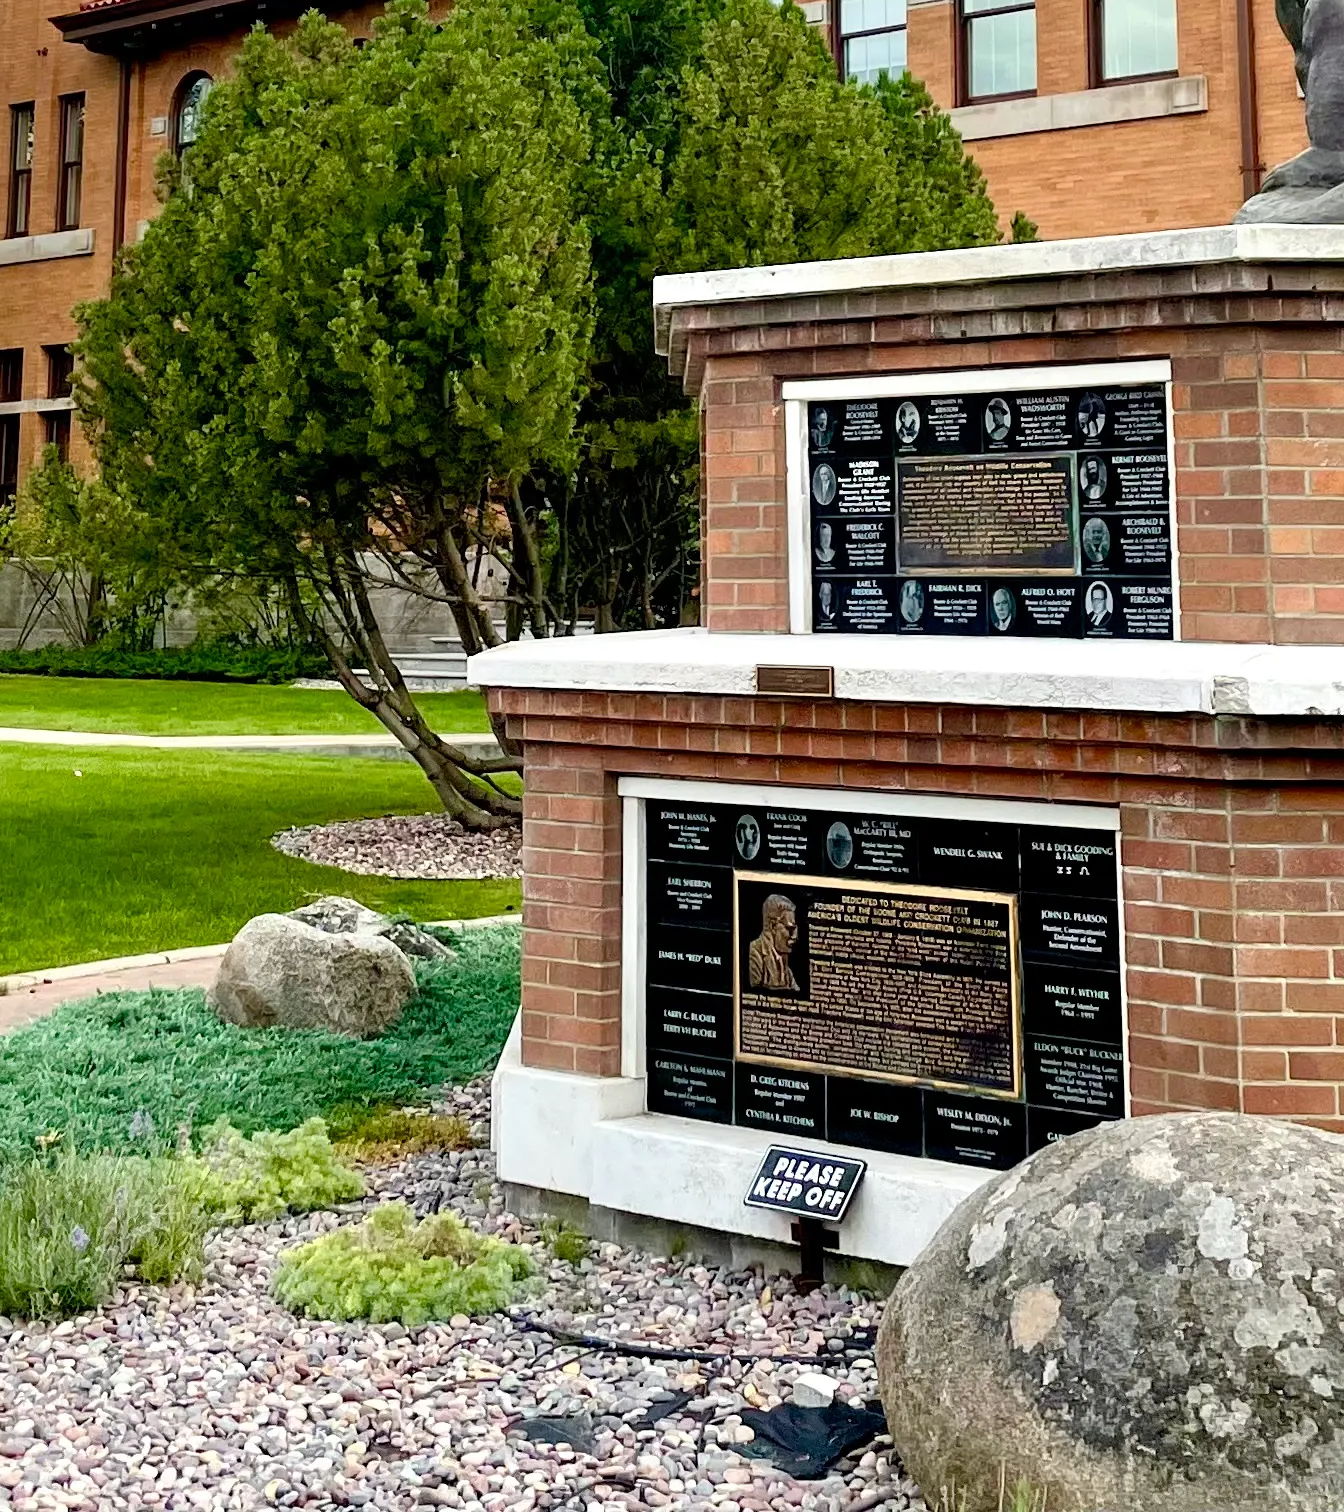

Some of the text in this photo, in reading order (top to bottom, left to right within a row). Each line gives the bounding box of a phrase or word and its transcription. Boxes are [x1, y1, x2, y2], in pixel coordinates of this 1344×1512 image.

[773, 1157, 845, 1187] PLEASE
[754, 1177, 845, 1210] KEEP OFF
